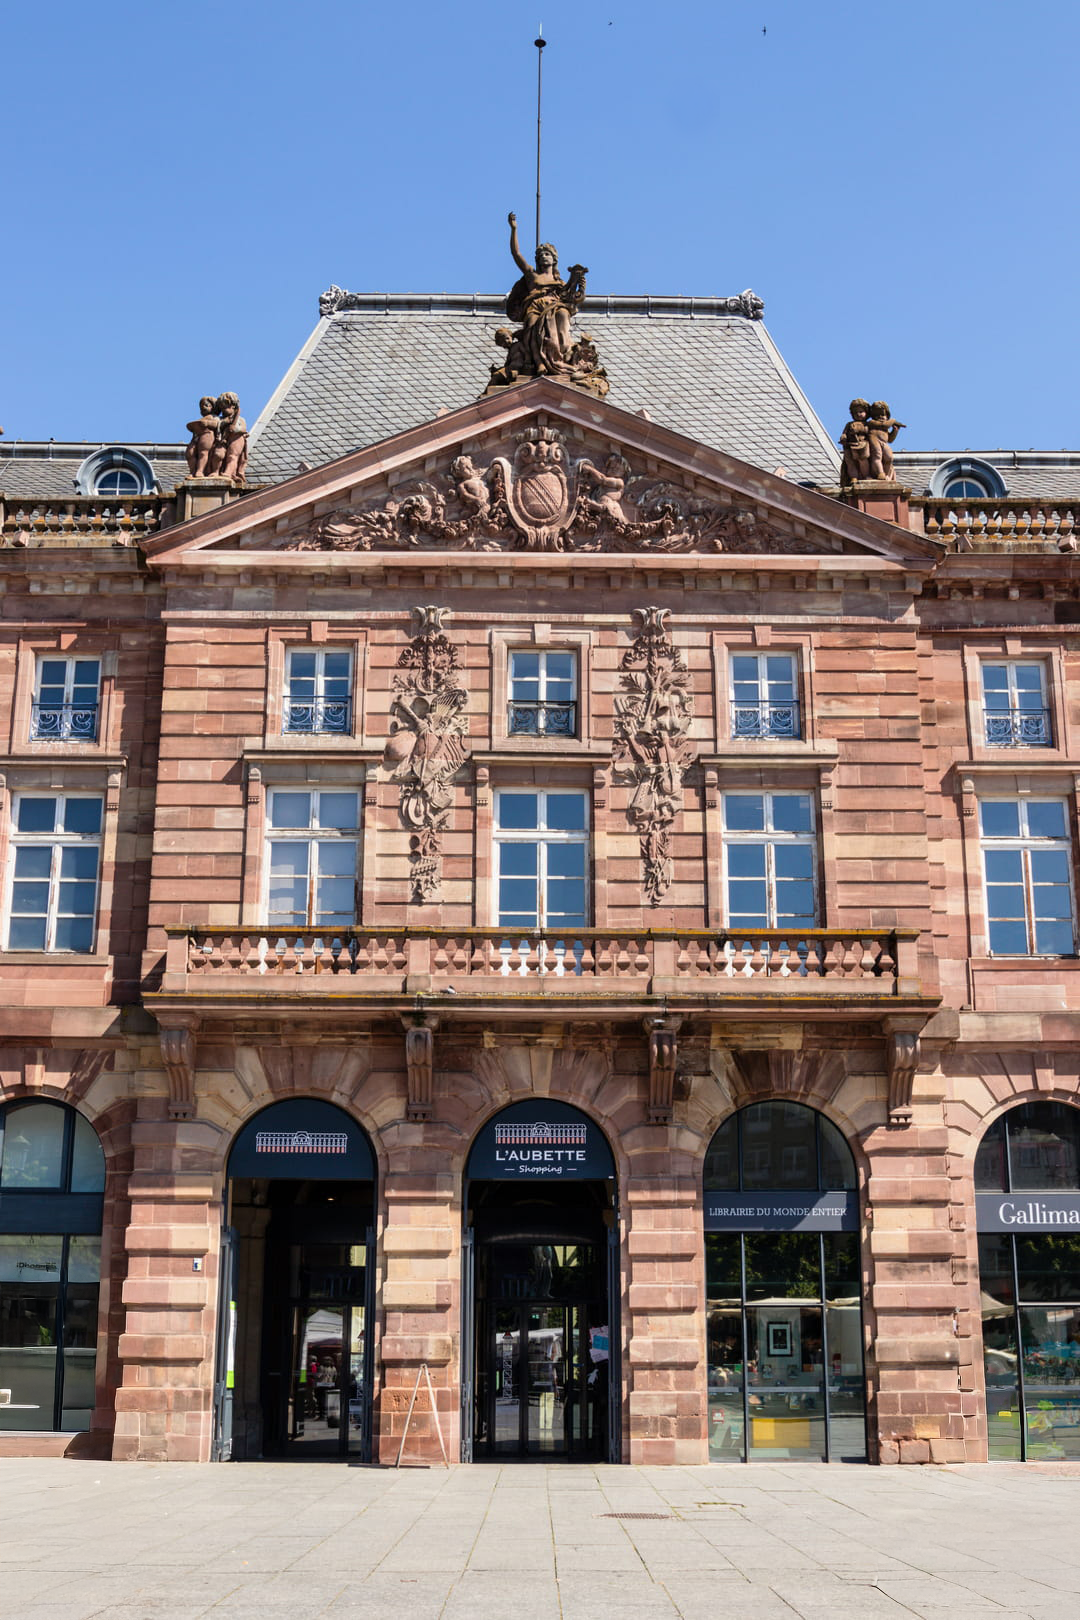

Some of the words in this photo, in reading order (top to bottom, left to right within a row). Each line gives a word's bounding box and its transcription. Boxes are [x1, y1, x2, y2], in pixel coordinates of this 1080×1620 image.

[496, 1150, 586, 1161] L'AUBETTE
[519, 1165, 563, 1174] Shopping
[709, 1207, 755, 1217] LIBRAIRIE
[756, 1207, 771, 1217] DU
[773, 1207, 810, 1217] MONDE
[811, 1207, 847, 1217] ENTIER
[998, 1202, 1080, 1225] Gallima
